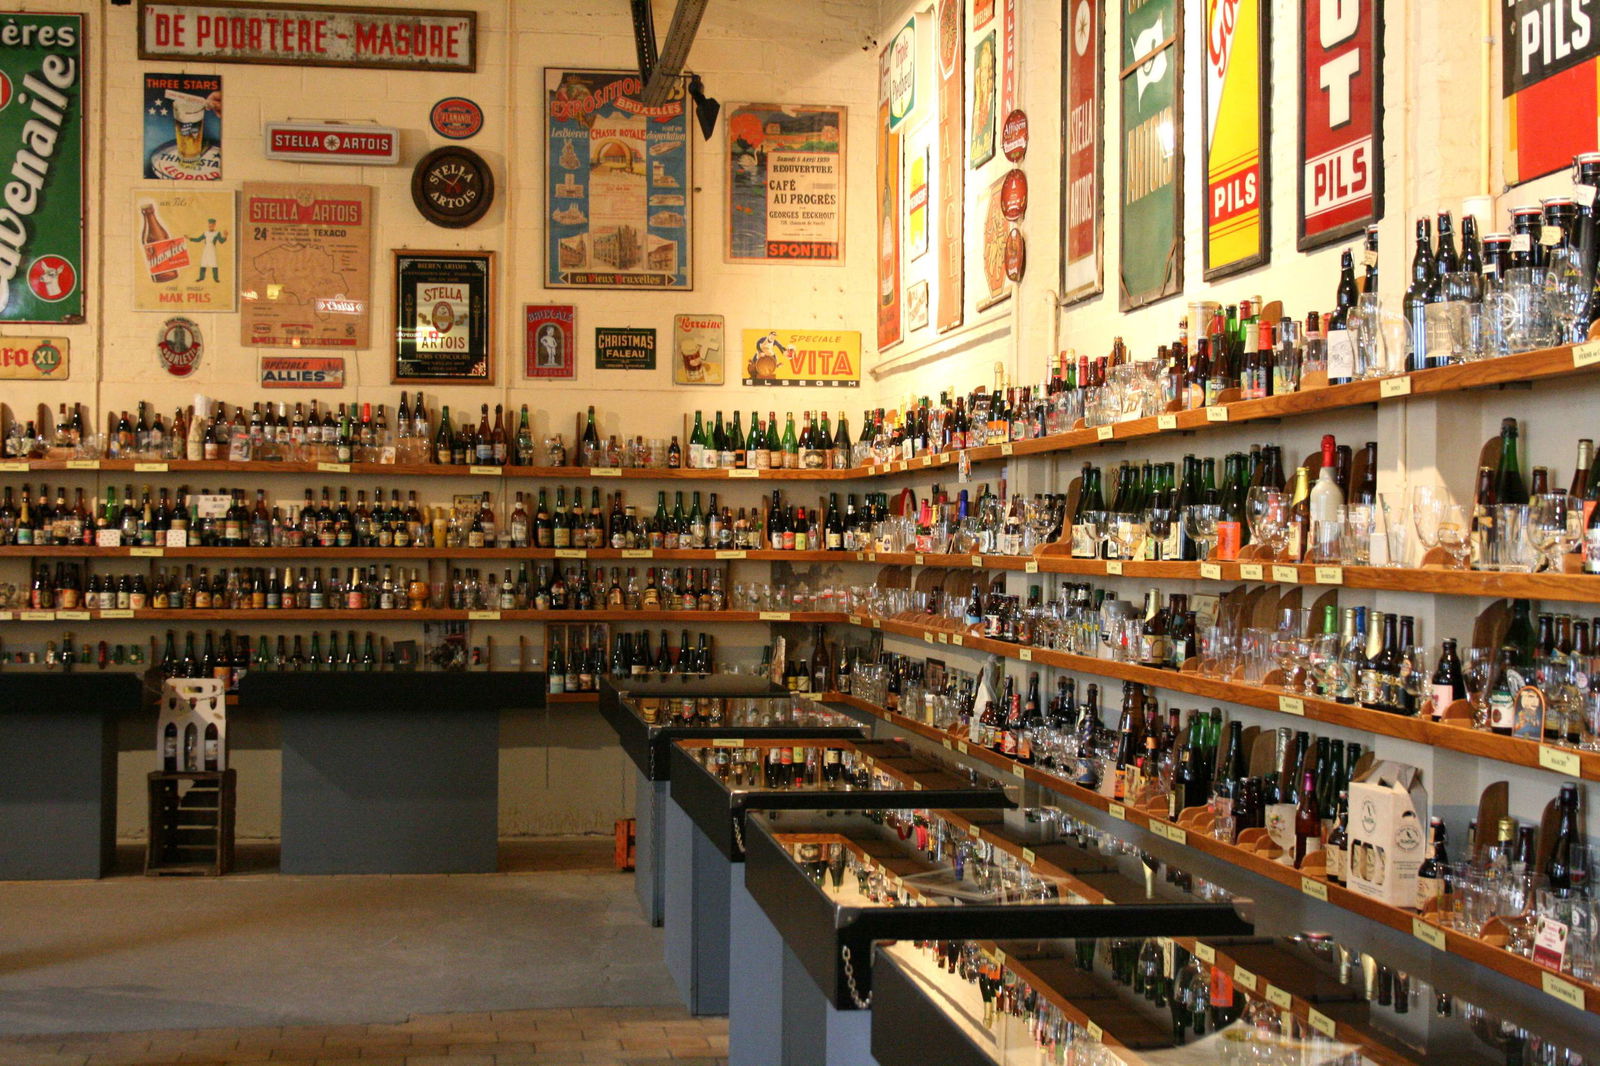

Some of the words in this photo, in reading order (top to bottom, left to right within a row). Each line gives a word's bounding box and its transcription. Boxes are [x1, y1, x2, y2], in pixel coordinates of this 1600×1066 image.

[1521, 0, 1591, 76] PILS
[146, 79, 180, 90] THREE
[183, 80, 219, 91] STARS
[1071, 98, 1093, 155] STELLA
[275, 134, 321, 149] STELLA
[342, 138, 390, 152] ARTOIS
[429, 164, 474, 187] STELLA
[1314, 147, 1367, 206] PILS
[769, 179, 796, 191] CAFÉ
[430, 189, 477, 208] ARTOIS
[774, 194, 787, 204] AU
[1070, 173, 1093, 229] ARTOIS
[1213, 172, 1257, 218] PILS
[253, 203, 298, 220] STELLA
[312, 205, 358, 222] ARTOIS
[254, 227, 267, 240] 24
[313, 229, 347, 238] TEXACO
[769, 244, 838, 256] SPONTIN
[187, 293, 212, 303] PILS
[423, 287, 463, 303] STELLA
[421, 336, 466, 349] ARTOIS
[598, 335, 654, 349] CHRISTMAS
[790, 334, 842, 343] SPECIALE
[37, 350, 56, 364] XL
[606, 349, 645, 358] FALEAU
[790, 350, 854, 375] VITA
[264, 370, 326, 381] ALLIES
